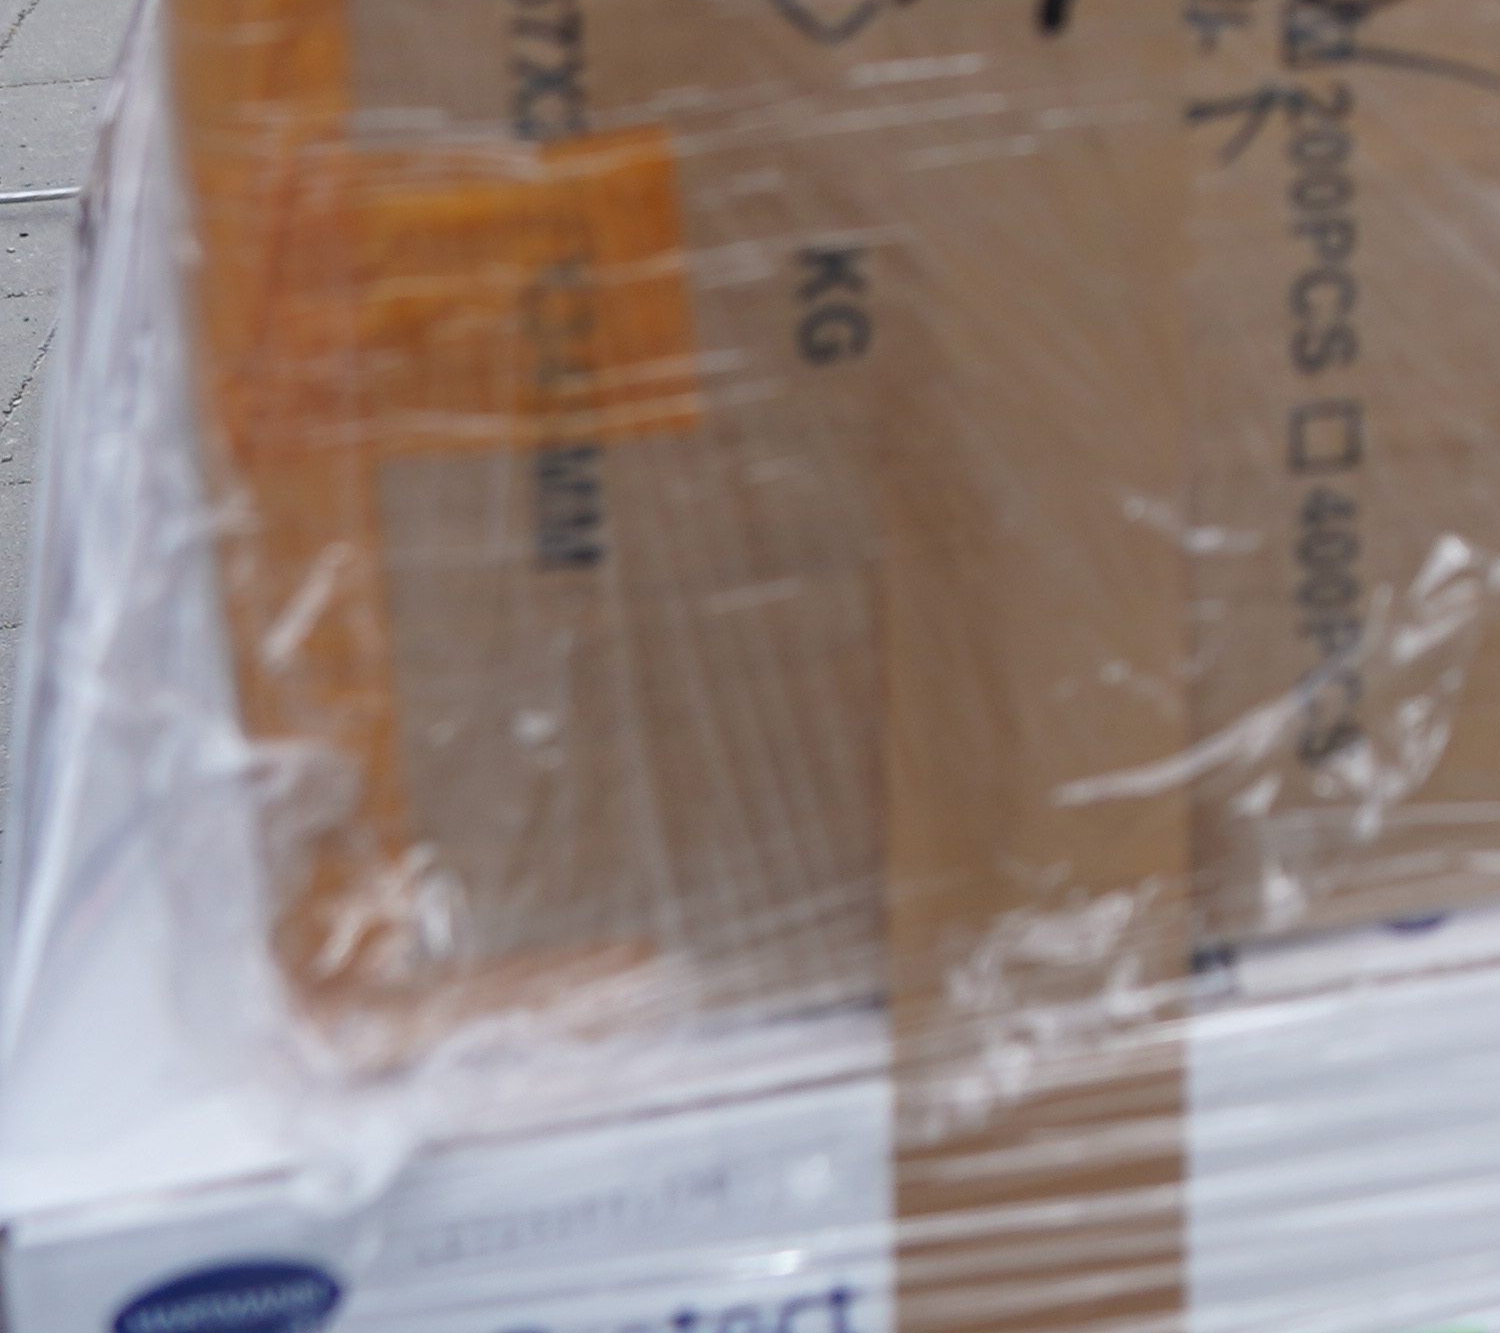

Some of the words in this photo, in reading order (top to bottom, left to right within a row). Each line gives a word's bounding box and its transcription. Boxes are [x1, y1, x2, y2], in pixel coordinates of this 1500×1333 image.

[1290, 78, 1358, 377] 200PCS
[797, 247, 872, 367] KG
[534, 443, 602, 571] MM
